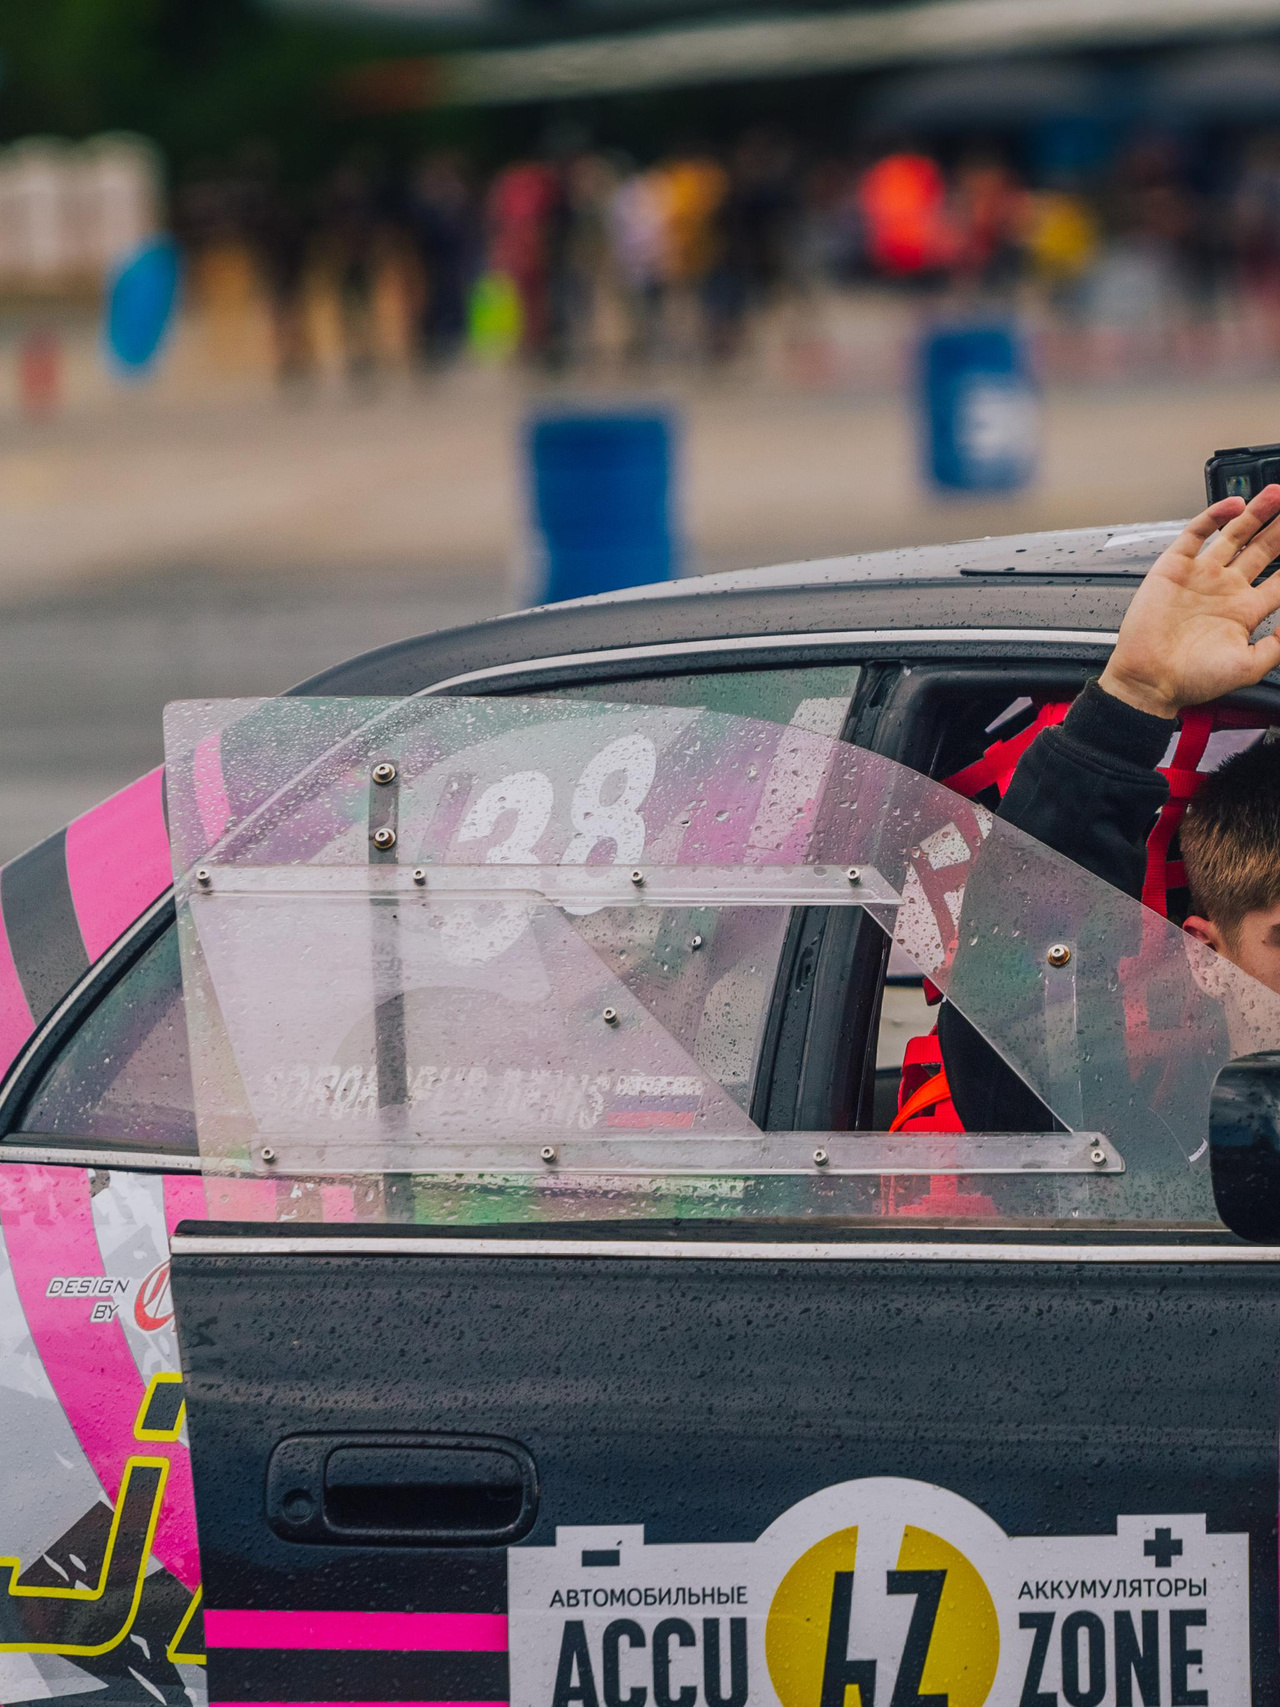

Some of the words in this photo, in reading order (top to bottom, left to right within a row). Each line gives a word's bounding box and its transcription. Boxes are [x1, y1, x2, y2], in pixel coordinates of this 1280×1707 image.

[437, 735, 656, 964] 38
[48, 1278, 130, 1295] DESIGN
[92, 1305, 119, 1320] BY
[549, 1585, 748, 1609] АВТОМОБИЛЬНЫЕ
[1017, 1577, 1208, 1601] АККУМУЛЯТОРЫ
[552, 1617, 748, 1707] ACCU
[1017, 1608, 1208, 1707] ZONE
